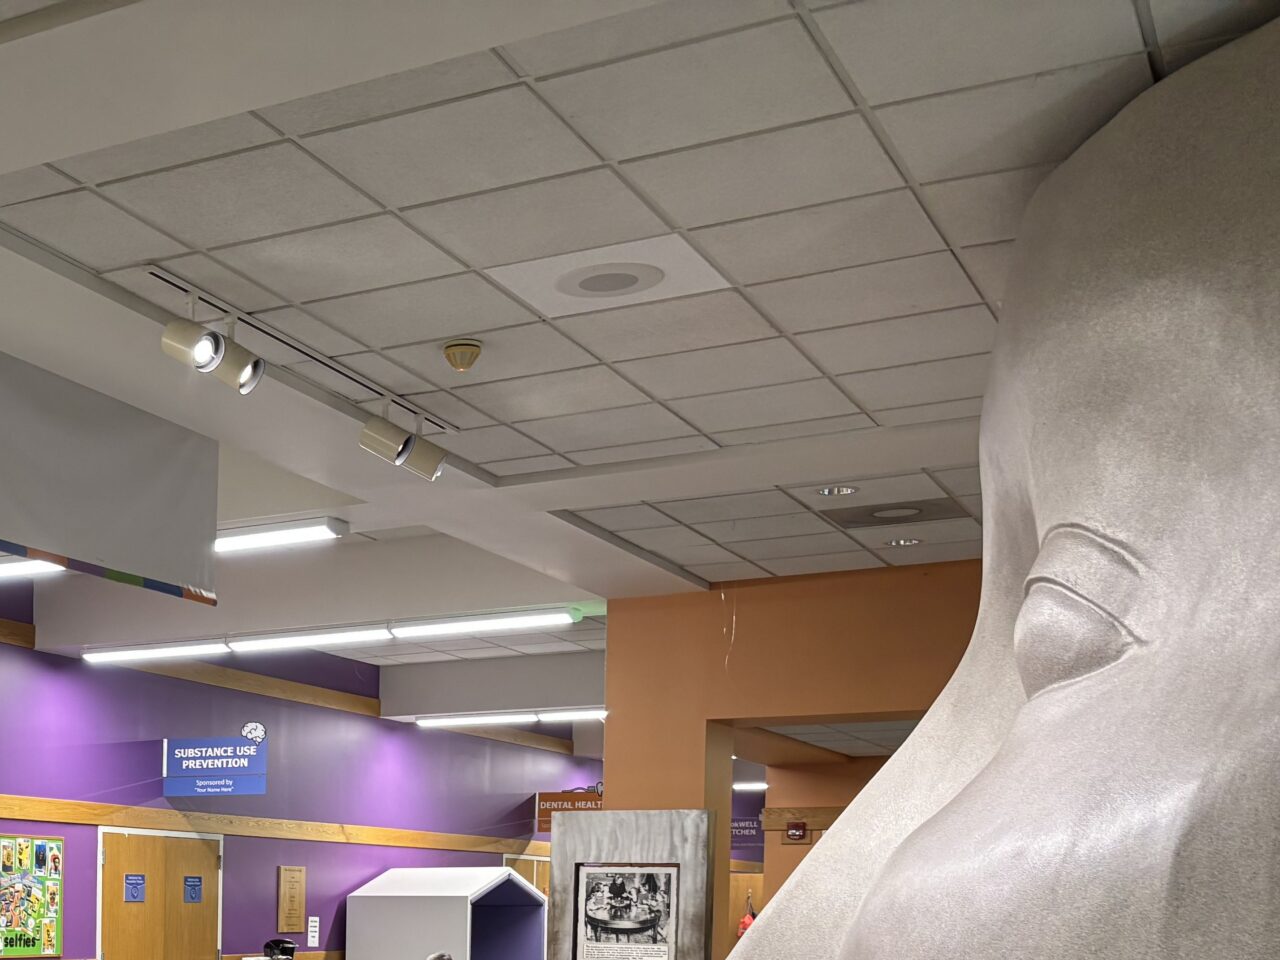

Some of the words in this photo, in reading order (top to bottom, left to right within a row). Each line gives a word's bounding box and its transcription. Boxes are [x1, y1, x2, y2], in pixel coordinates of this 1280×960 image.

[174, 747, 234, 758] SUBSTANCE
[236, 746, 257, 756] USE
[182, 758, 248, 769] PREVENTION
[540, 801, 574, 809] DENTAL
[575, 801, 603, 809] HEALT
[4, 934, 36, 948] selfies
